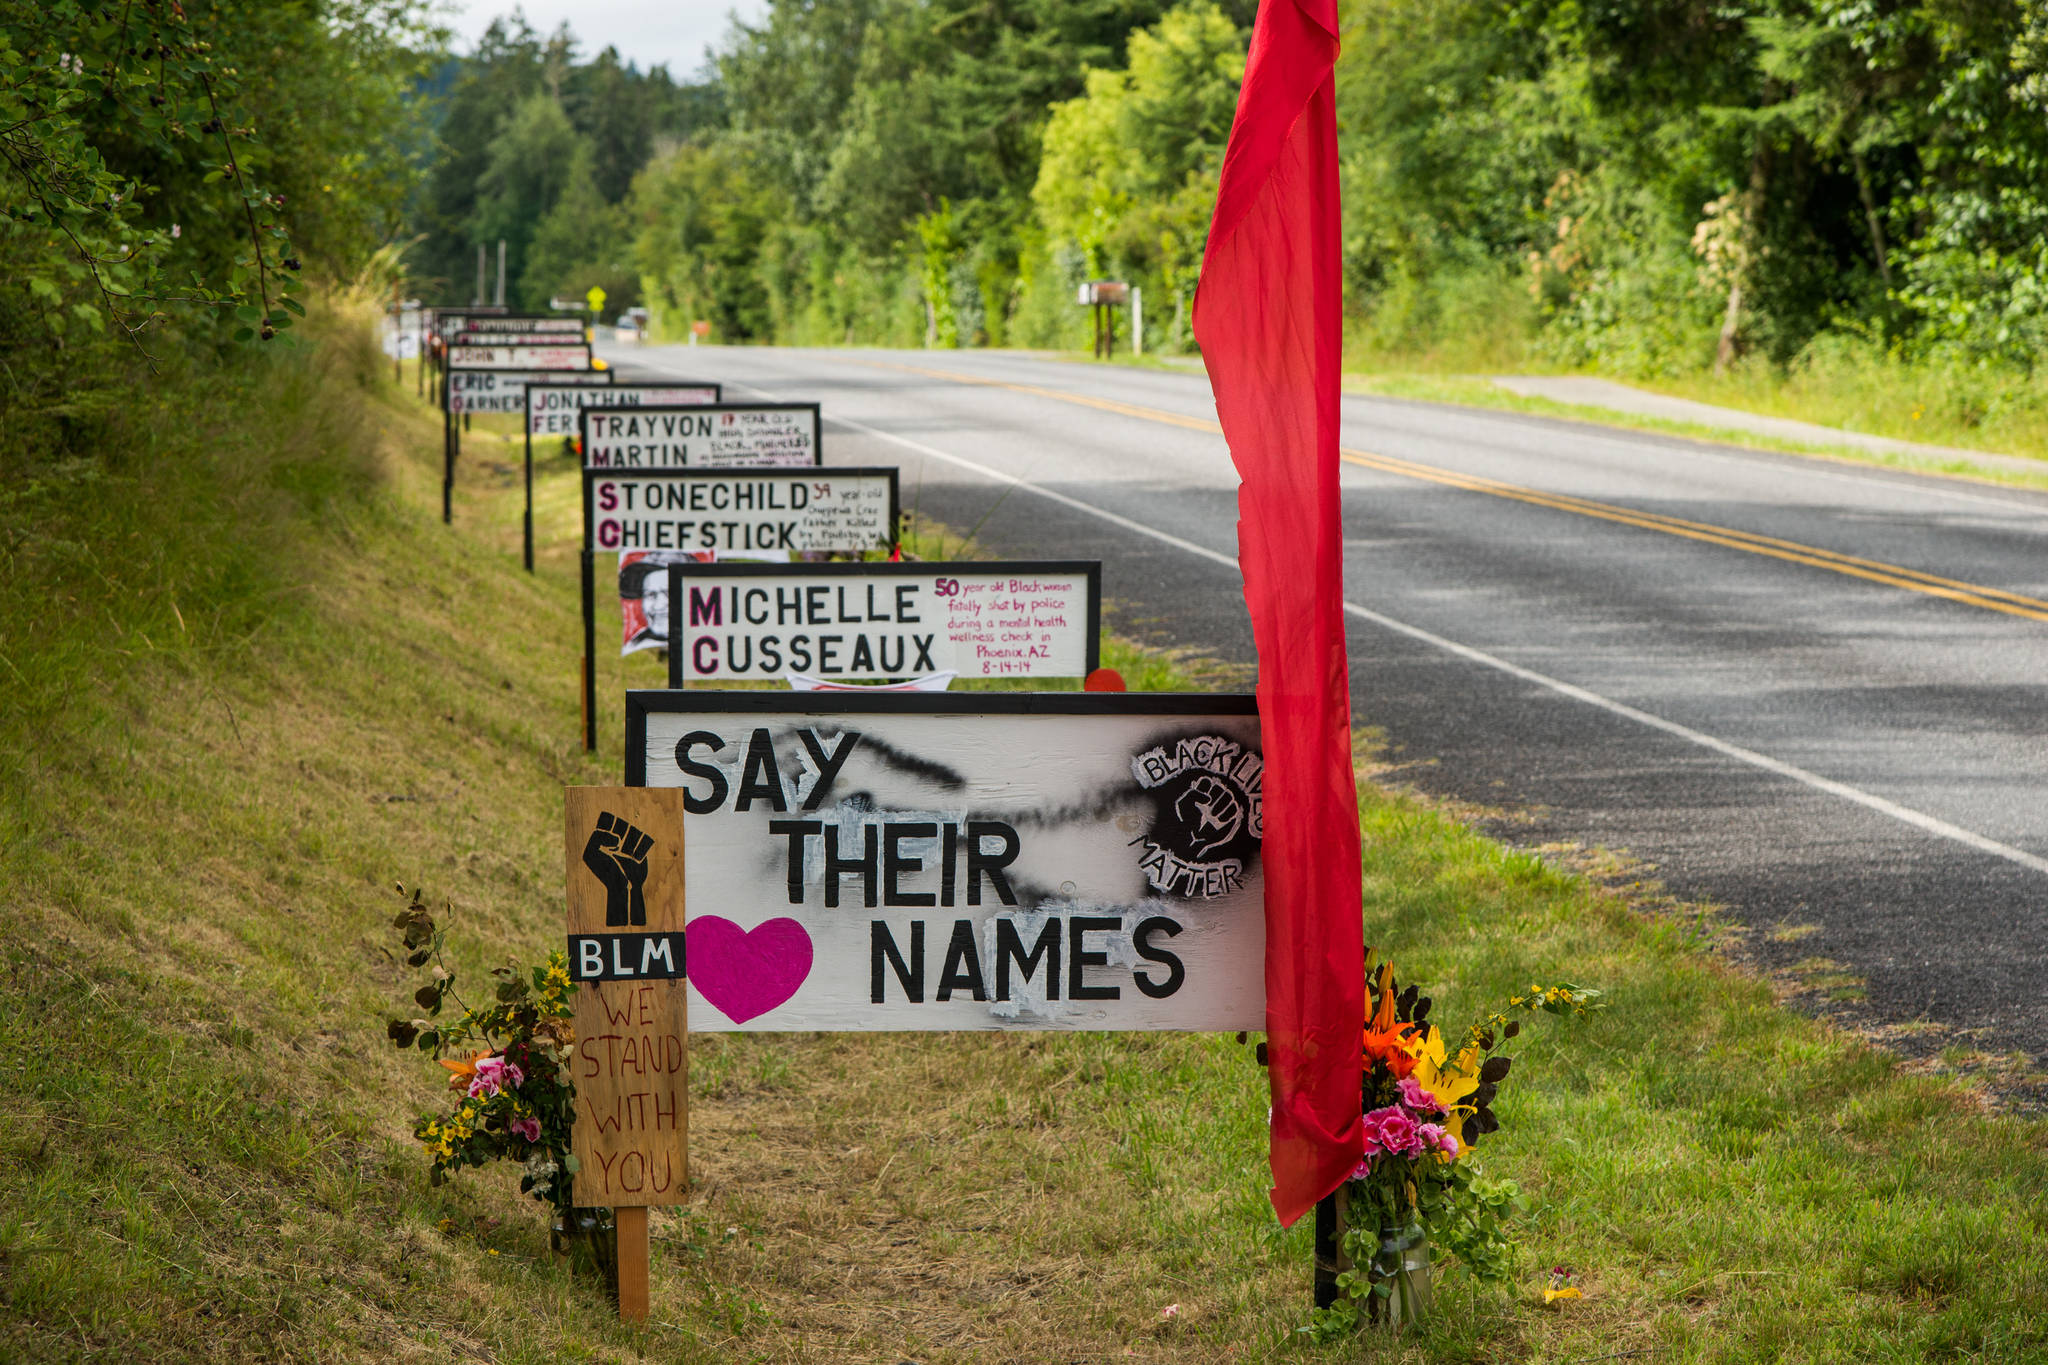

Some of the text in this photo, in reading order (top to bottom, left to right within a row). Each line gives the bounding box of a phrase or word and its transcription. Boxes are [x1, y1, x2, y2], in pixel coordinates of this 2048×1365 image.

[453, 376, 496, 392] ERIC
[534, 391, 641, 409] JONATHAN
[451, 396, 526, 411] GARNER
[592, 415, 712, 438] TRAYVON
[592, 444, 688, 466] MARTIN
[599, 482, 809, 511] STONECHILD
[599, 518, 799, 550] CHIEFSTICK
[690, 584, 921, 627] MICHELLE
[934, 577, 960, 597] 50
[962, 583, 985, 599] year
[990, 581, 1004, 592] old
[1009, 579, 1041, 594] Black
[947, 598, 1065, 617] fatally shot by police
[947, 615, 1067, 632] during a mental health
[948, 630, 1051, 642] wellness check in
[693, 633, 936, 675] CUSSEAUX
[982, 660, 1031, 674] 8-14-14
[674, 726, 862, 815] SAY
[1142, 739, 1234, 783] BLACK
[769, 820, 1021, 908] THEIR
[1127, 833, 1244, 897] MATTER
[579, 937, 676, 978] BLM
[870, 915, 1185, 1004] NAMES
[600, 987, 655, 1026] WE
[581, 1034, 683, 1078] STAND
[586, 1090, 677, 1134] WITH
[594, 1150, 672, 1195] YOU
